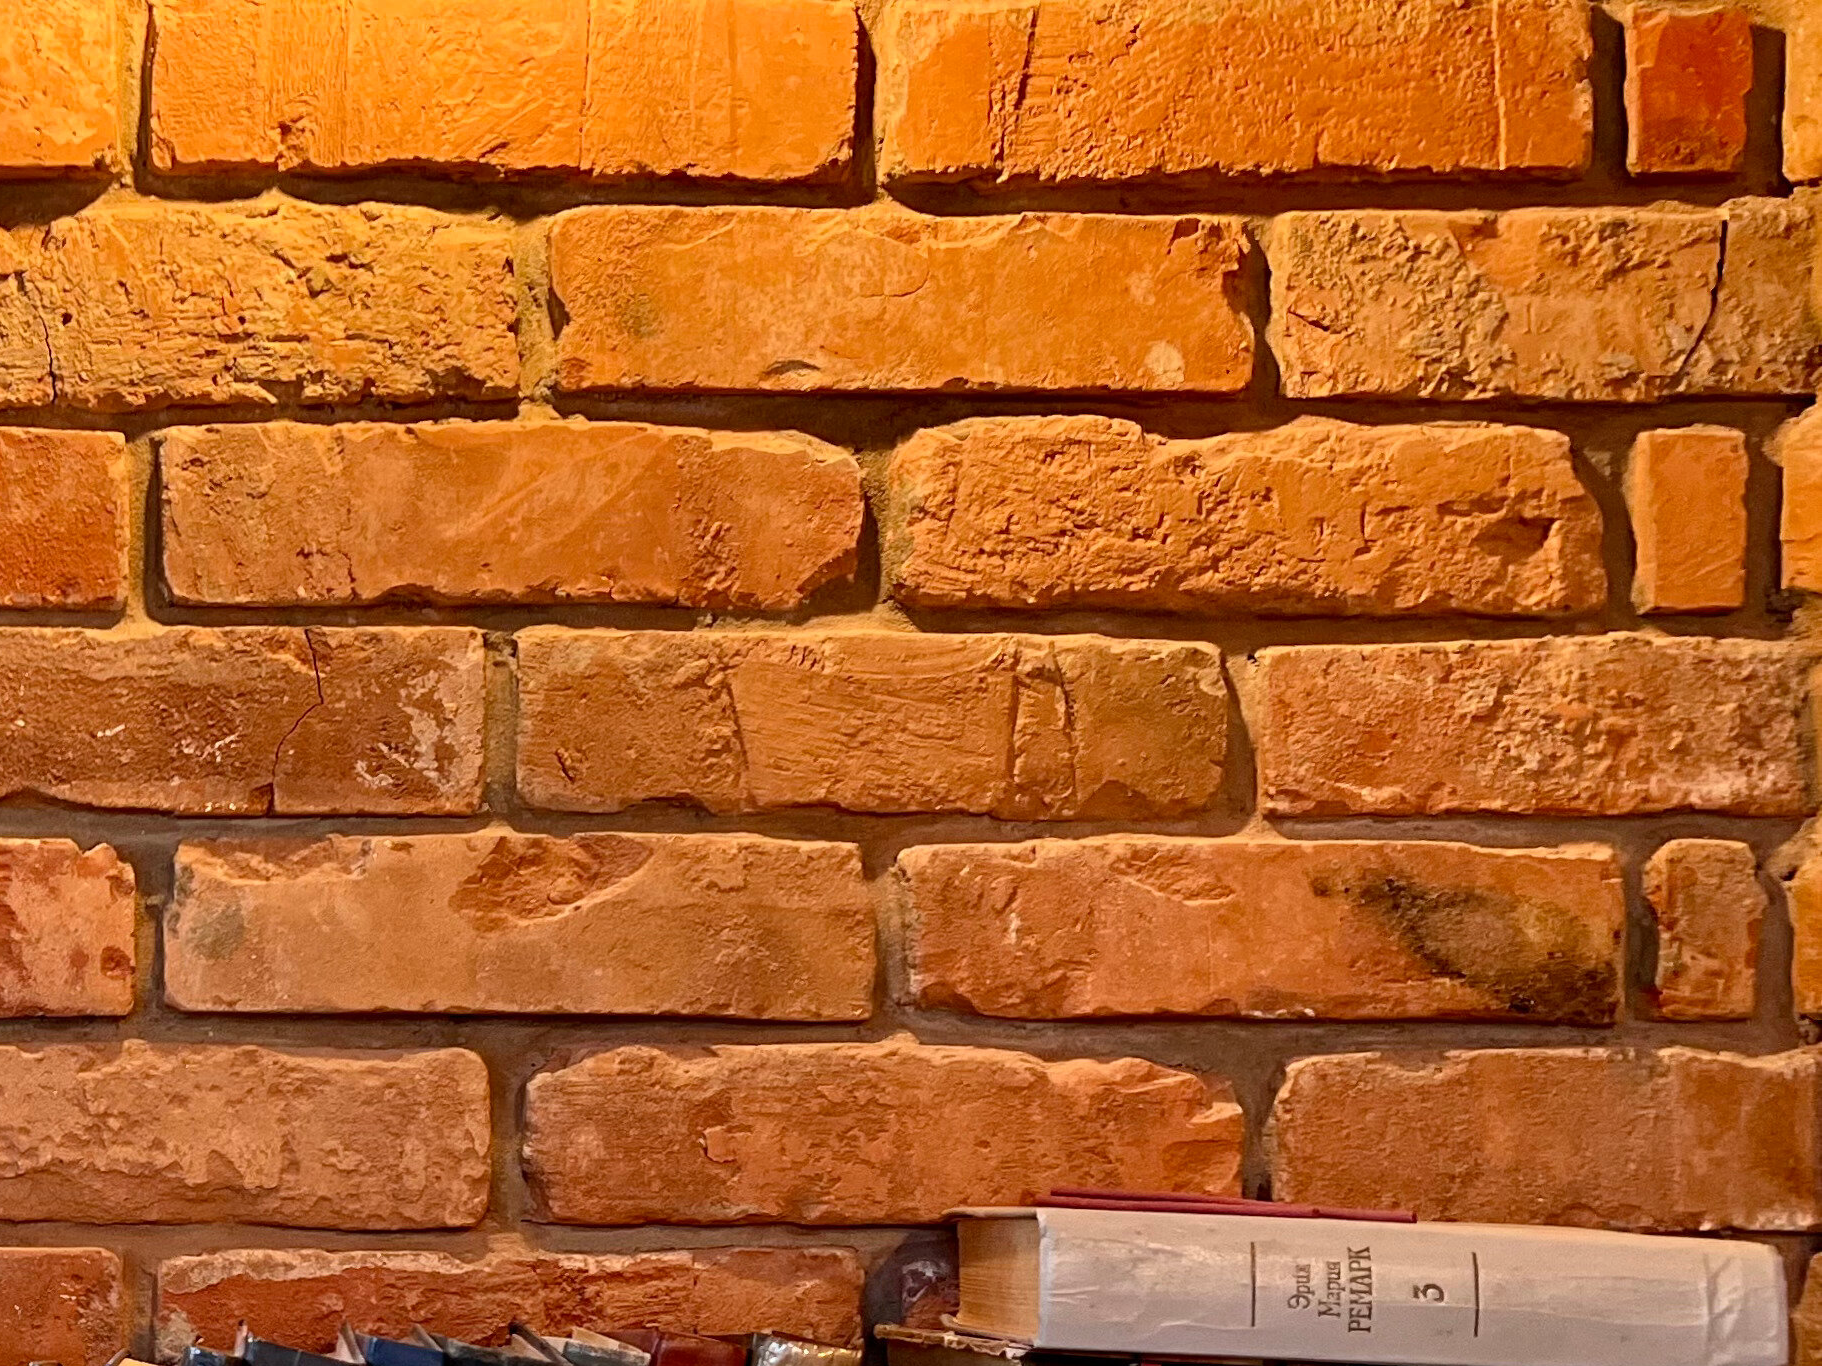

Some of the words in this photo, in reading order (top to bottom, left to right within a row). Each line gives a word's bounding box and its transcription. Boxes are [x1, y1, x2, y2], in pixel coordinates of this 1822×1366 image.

[1288, 1263, 1312, 1310] Эрих
[1318, 1261, 1347, 1318] Мария
[1348, 1245, 1374, 1333] РЕМАРК
[1413, 1282, 1445, 1303] 3
